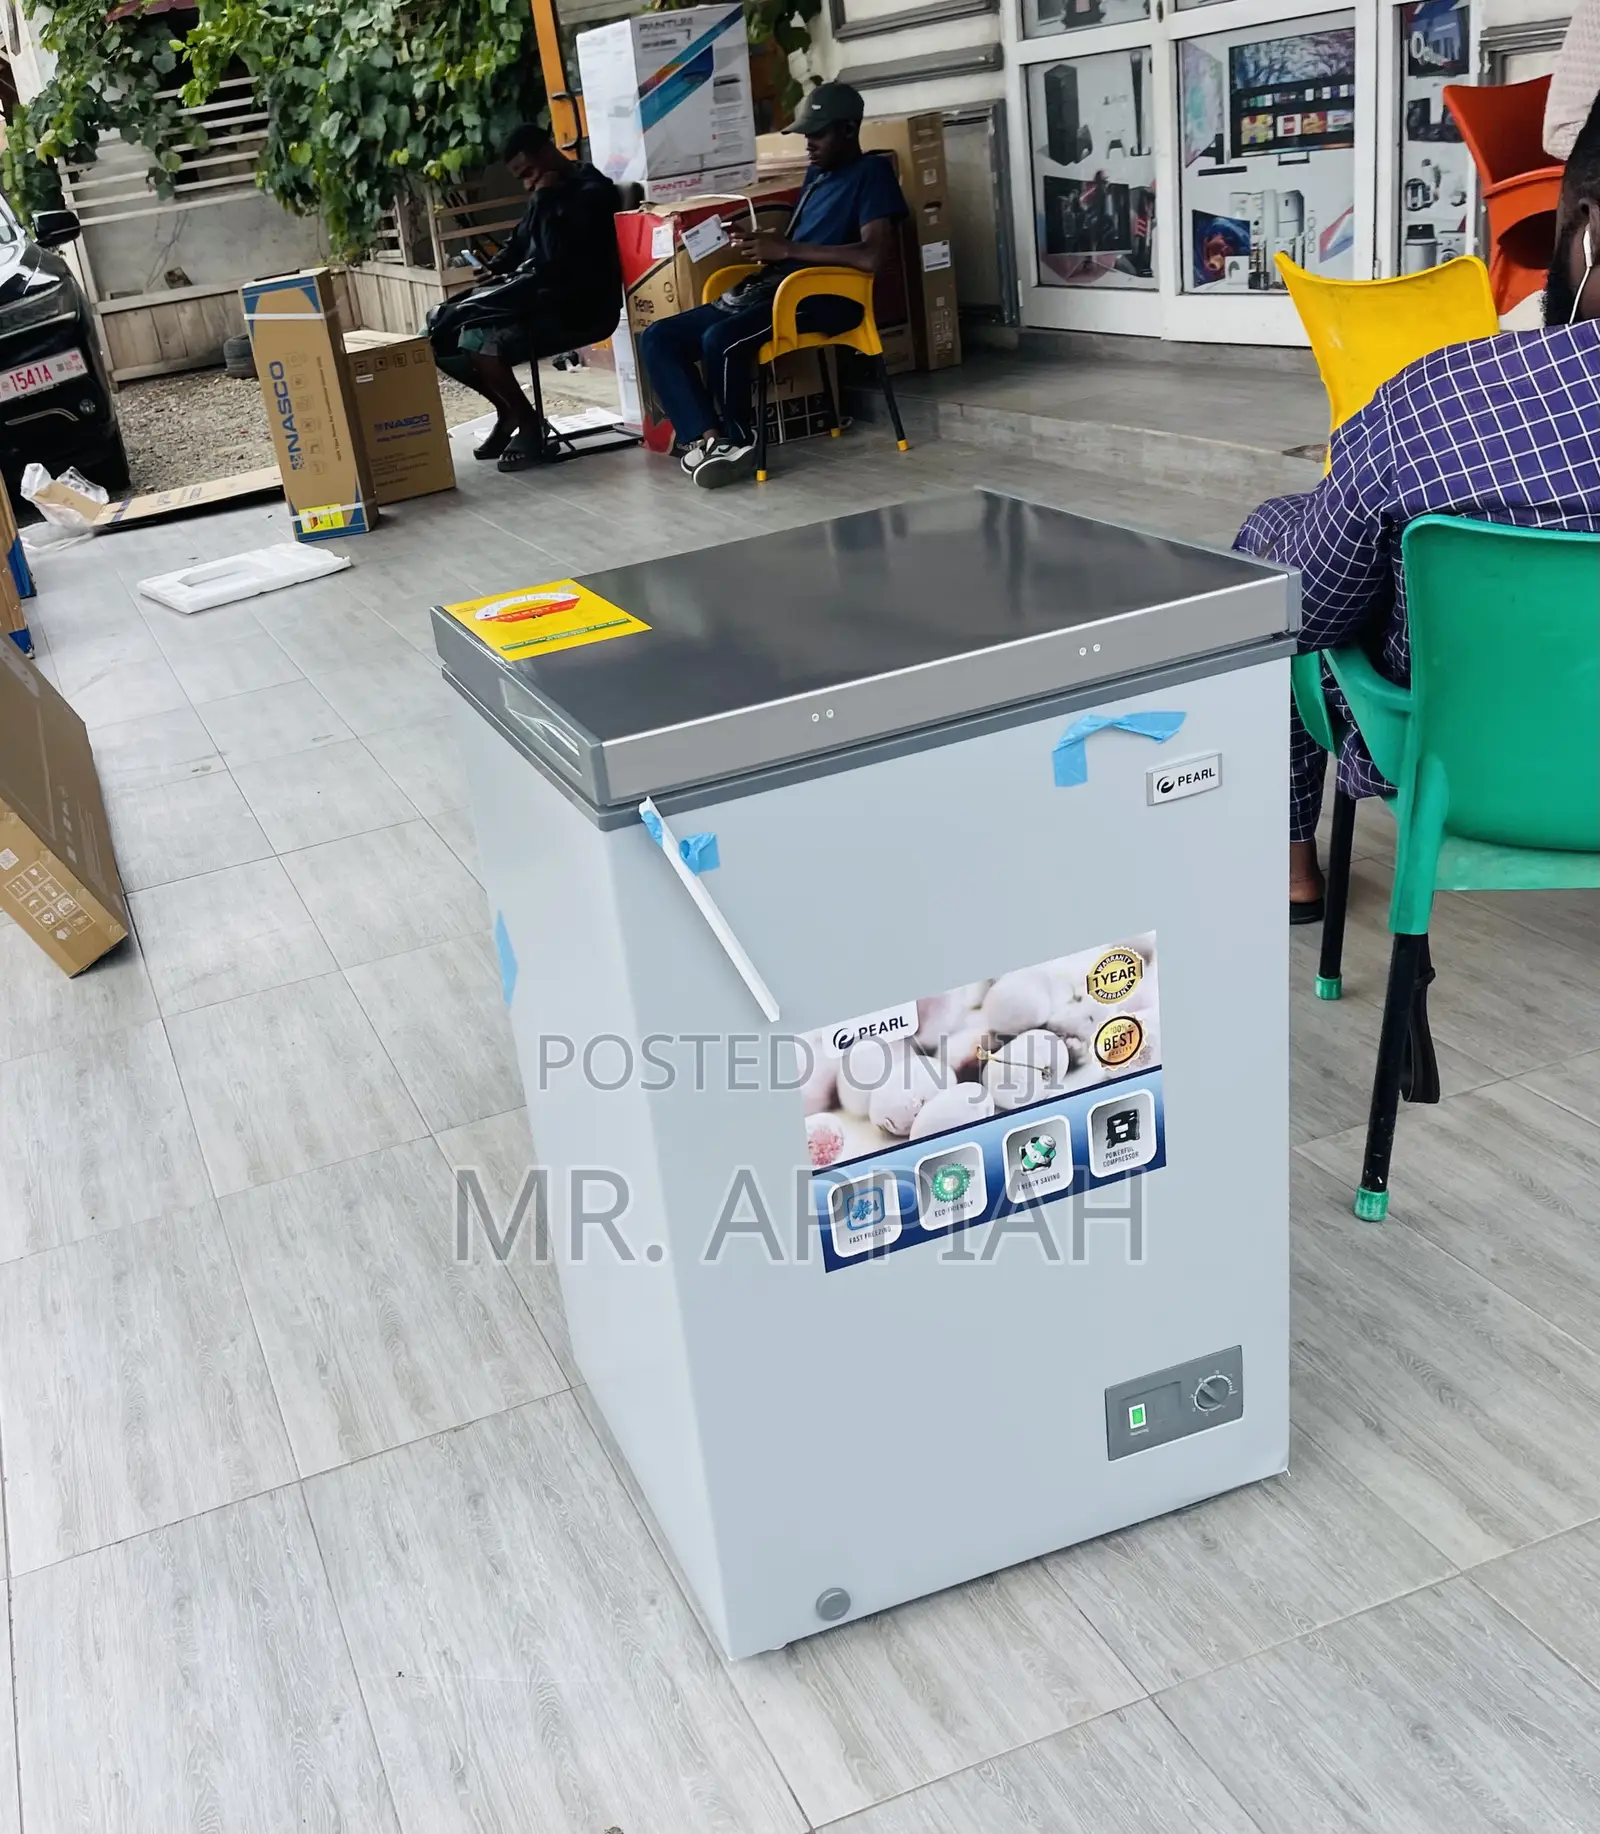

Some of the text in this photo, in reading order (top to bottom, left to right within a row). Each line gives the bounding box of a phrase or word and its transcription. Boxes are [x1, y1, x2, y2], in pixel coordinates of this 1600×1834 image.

[269, 361, 301, 453] NASCO
[384, 413, 430, 431] NASCO
[1177, 767, 1216, 787] PEARL
[1097, 954, 1132, 973] WARRANTY
[1101, 966, 1137, 985] YEAR
[1097, 981, 1133, 1000] WARRANTY
[858, 1015, 909, 1040] PEARL
[1103, 1030, 1135, 1052] BEST
[1102, 1151, 1140, 1168] COMPRESSOR
[1105, 1147, 1135, 1160] POWERFUL
[1017, 1172, 1061, 1191] ENERGY SAVING
[934, 1200, 974, 1218] ECO-FRIENDLY
[849, 1225, 892, 1245] FAST FREEZING
